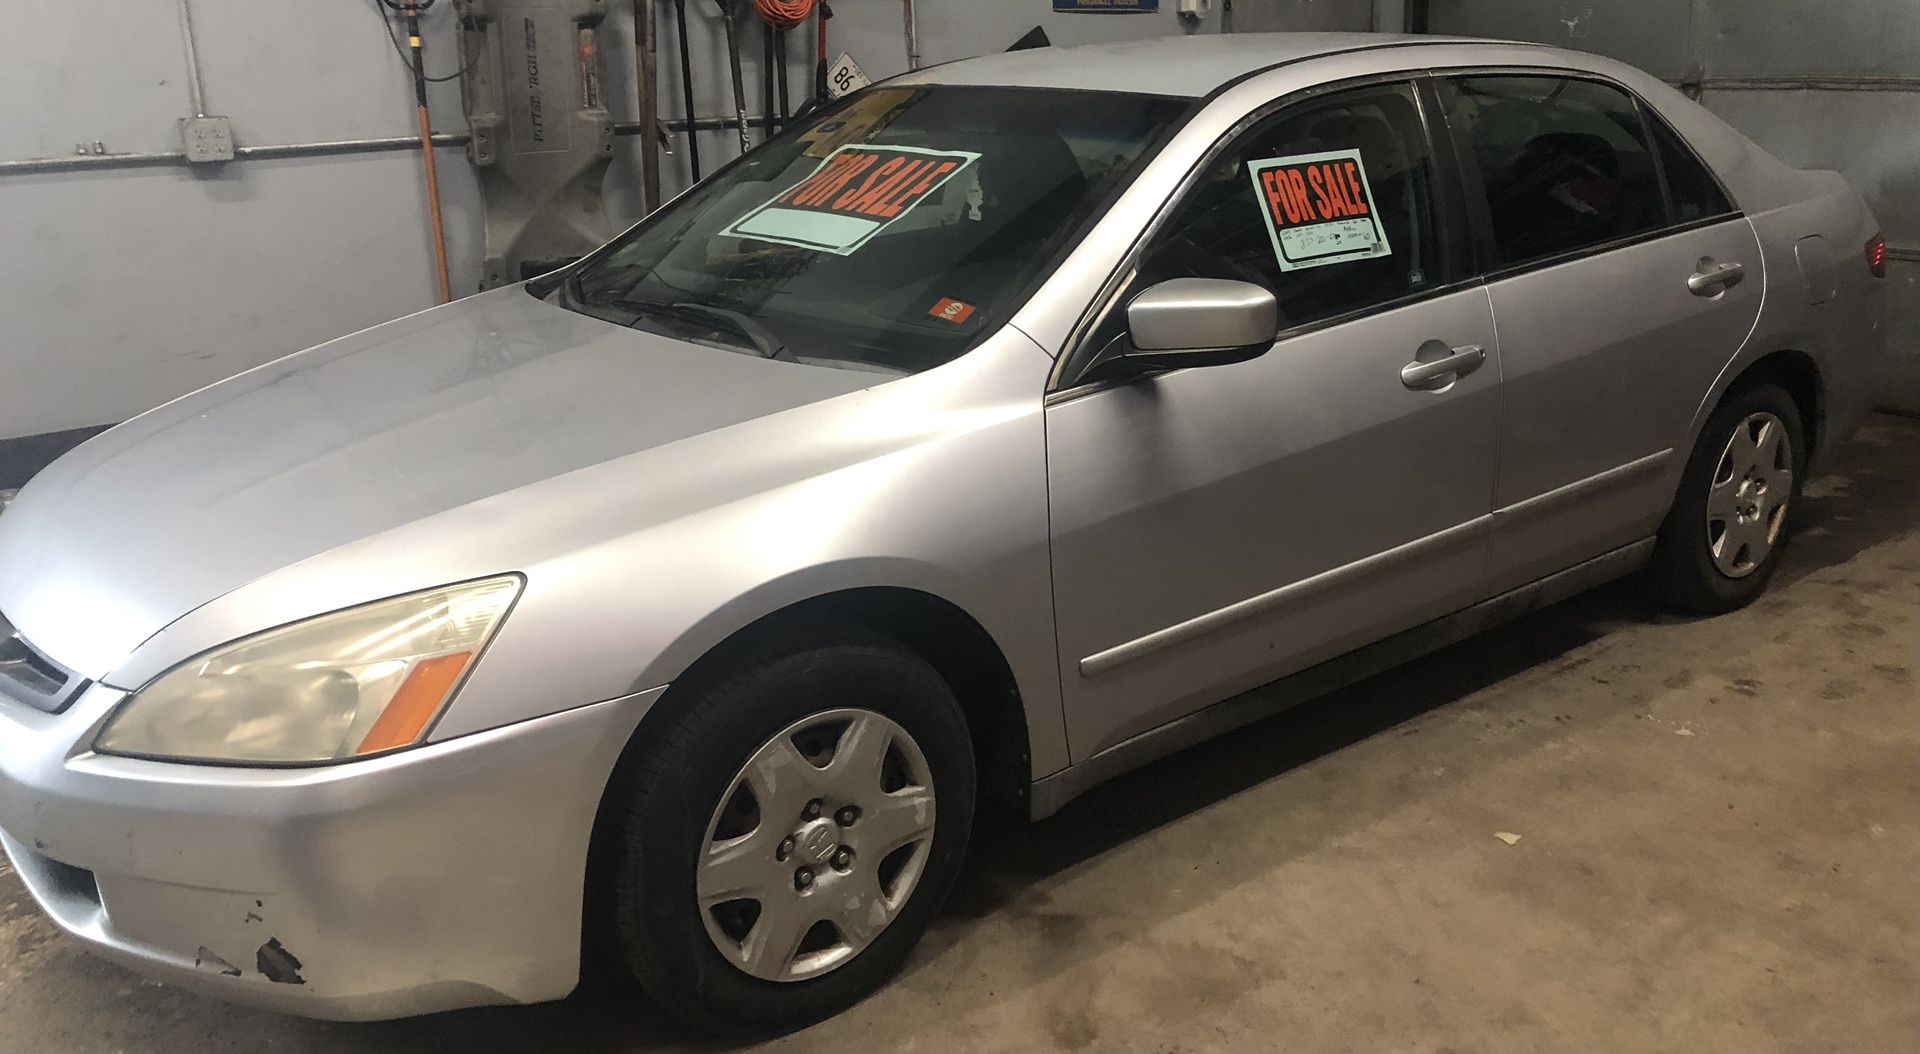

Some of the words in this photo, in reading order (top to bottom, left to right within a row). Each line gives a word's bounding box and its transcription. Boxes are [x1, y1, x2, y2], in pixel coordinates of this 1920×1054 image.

[527, 54, 544, 142] PITTSBRGH
[834, 66, 855, 91] 86
[779, 154, 878, 207] FOR
[831, 156, 957, 218] SALE
[1262, 169, 1316, 225] FOR
[1307, 162, 1368, 220] SALE
